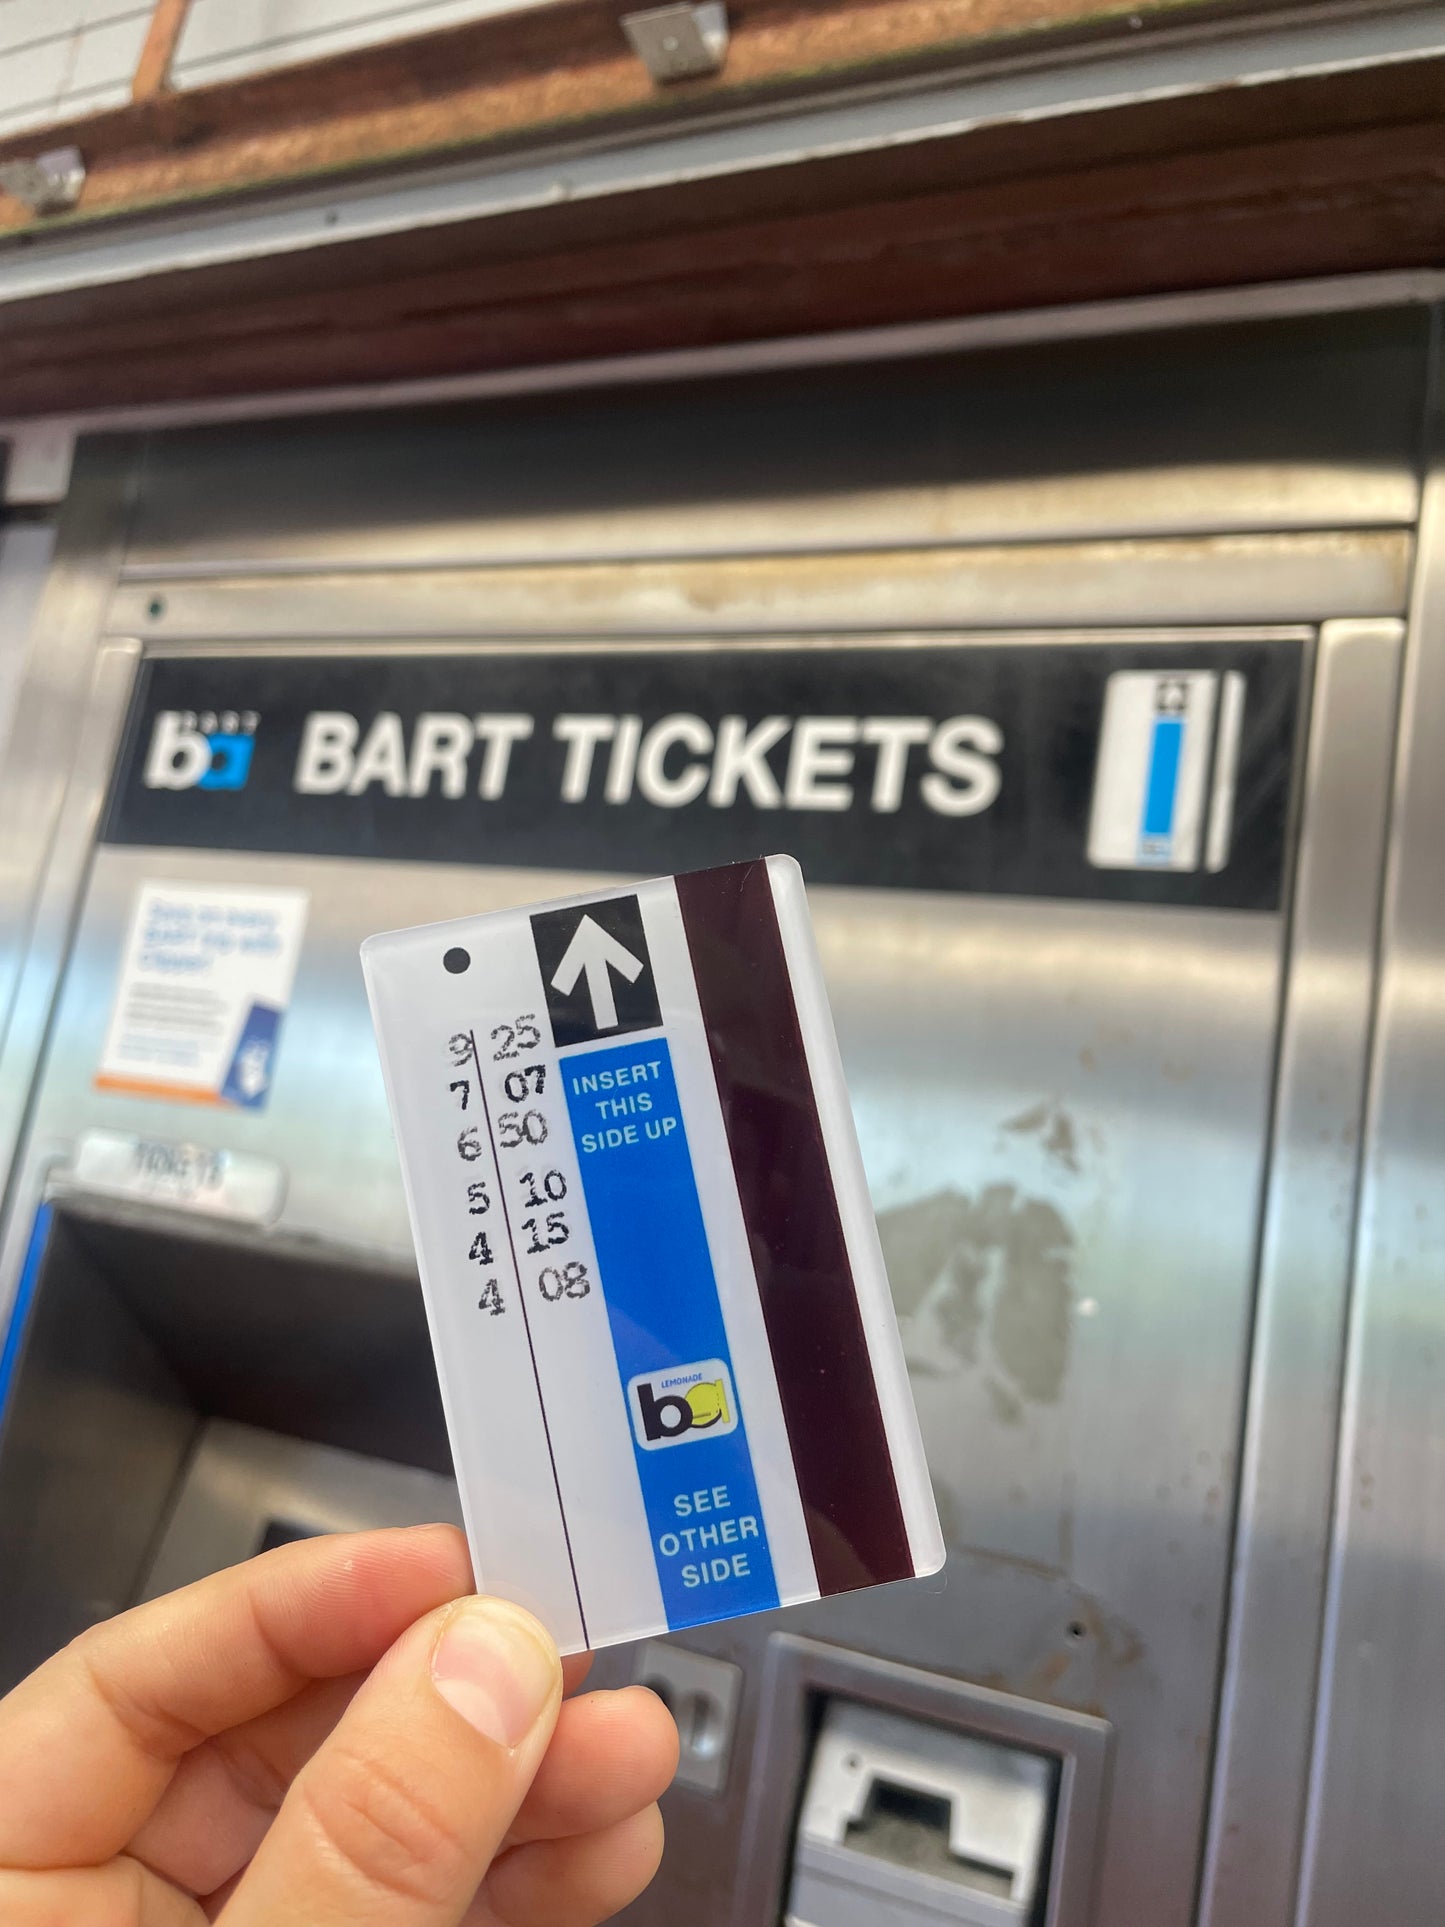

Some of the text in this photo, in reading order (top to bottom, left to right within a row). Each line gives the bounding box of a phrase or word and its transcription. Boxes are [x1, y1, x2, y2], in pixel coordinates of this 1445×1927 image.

[295, 711, 1004, 817] BART TICKETS
[448, 1013, 541, 1066] 9 25
[450, 1064, 546, 1110] 7 07
[572, 1060, 663, 1095] INSERT
[595, 1092, 653, 1120] THIS
[457, 1109, 548, 1161] 6 50
[581, 1116, 678, 1154] SIDE UP
[467, 1169, 568, 1215] 5 10
[468, 1211, 570, 1265] 4 15
[478, 1261, 591, 1316] 4 08
[661, 1373, 703, 1389] LEMONADE
[673, 1485, 731, 1517] SEE
[659, 1515, 759, 1557] OTHER
[681, 1553, 751, 1588] SIDE
